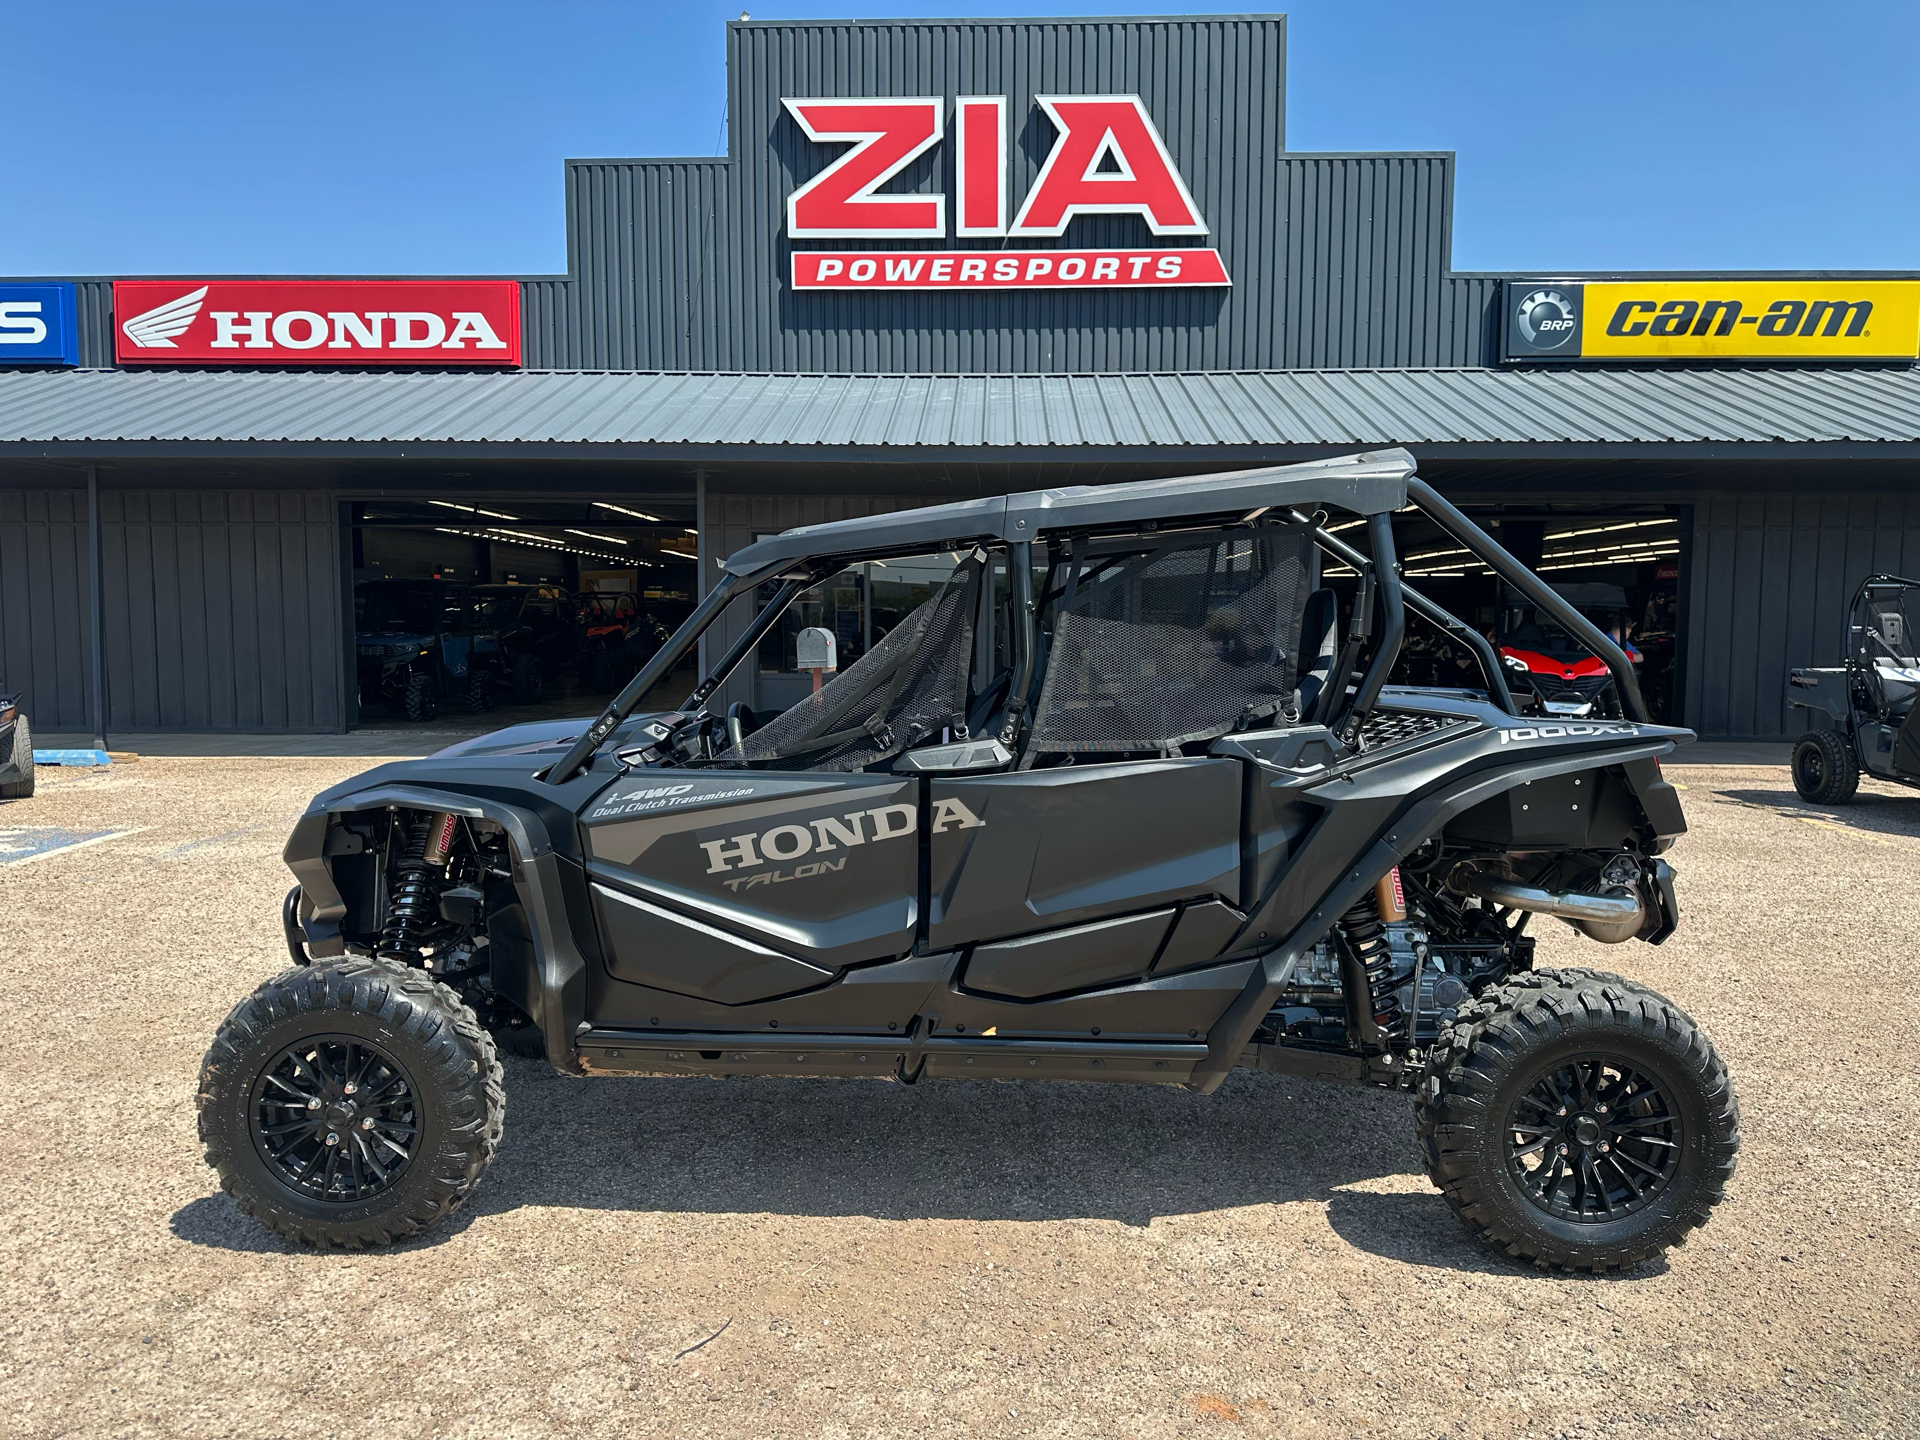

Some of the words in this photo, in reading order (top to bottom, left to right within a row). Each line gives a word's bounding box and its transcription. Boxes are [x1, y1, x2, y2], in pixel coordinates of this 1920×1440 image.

[780, 94, 1210, 239] ZIA
[816, 256, 1183, 283] POWERSPORTS
[210, 310, 507, 350] HONDA
[1539, 319, 1575, 332] BRP
[592, 805, 625, 818] Dual
[624, 799, 667, 813] Clutch
[668, 787, 755, 806] Transmission
[439, 814, 455, 852] SHOWA
[699, 796, 986, 875] HONDA
[722, 856, 847, 893] TALON
[1391, 864, 1405, 906] HOWA
